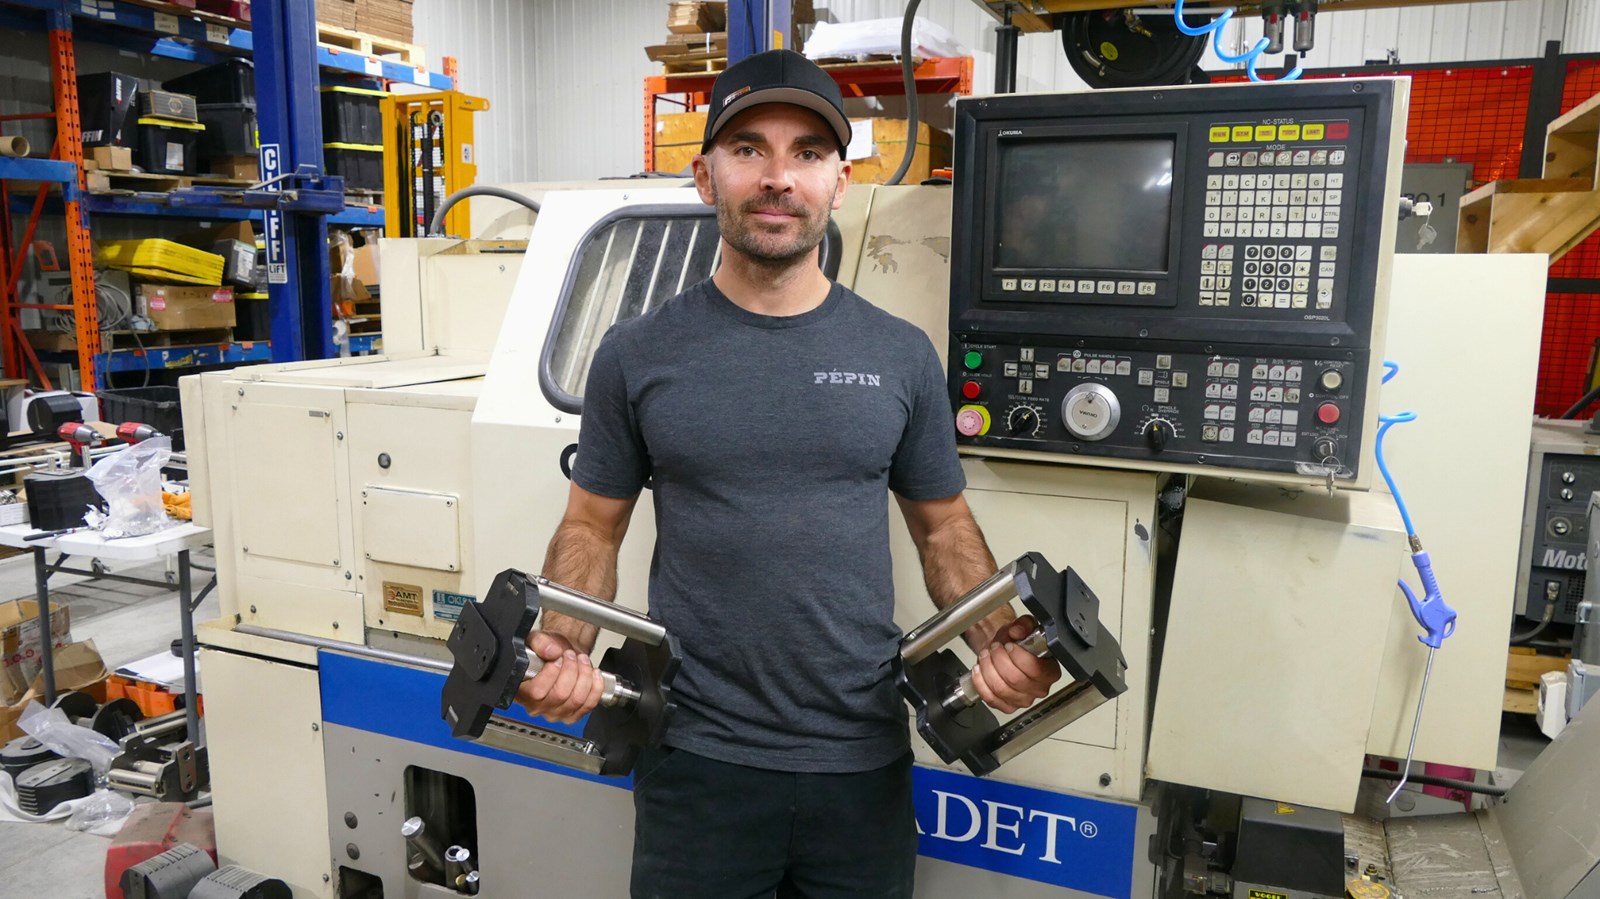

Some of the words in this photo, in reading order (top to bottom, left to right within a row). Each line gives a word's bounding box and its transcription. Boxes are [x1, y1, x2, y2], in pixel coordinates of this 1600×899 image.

[82, 130, 104, 142] FFIN
[264, 148, 280, 262] CLFF
[1438, 192, 1445, 206] 1
[814, 368, 880, 386] PÉPIN
[1542, 549, 1588, 570] Mot
[396, 591, 417, 600] AMT
[915, 789, 1076, 864] DET
